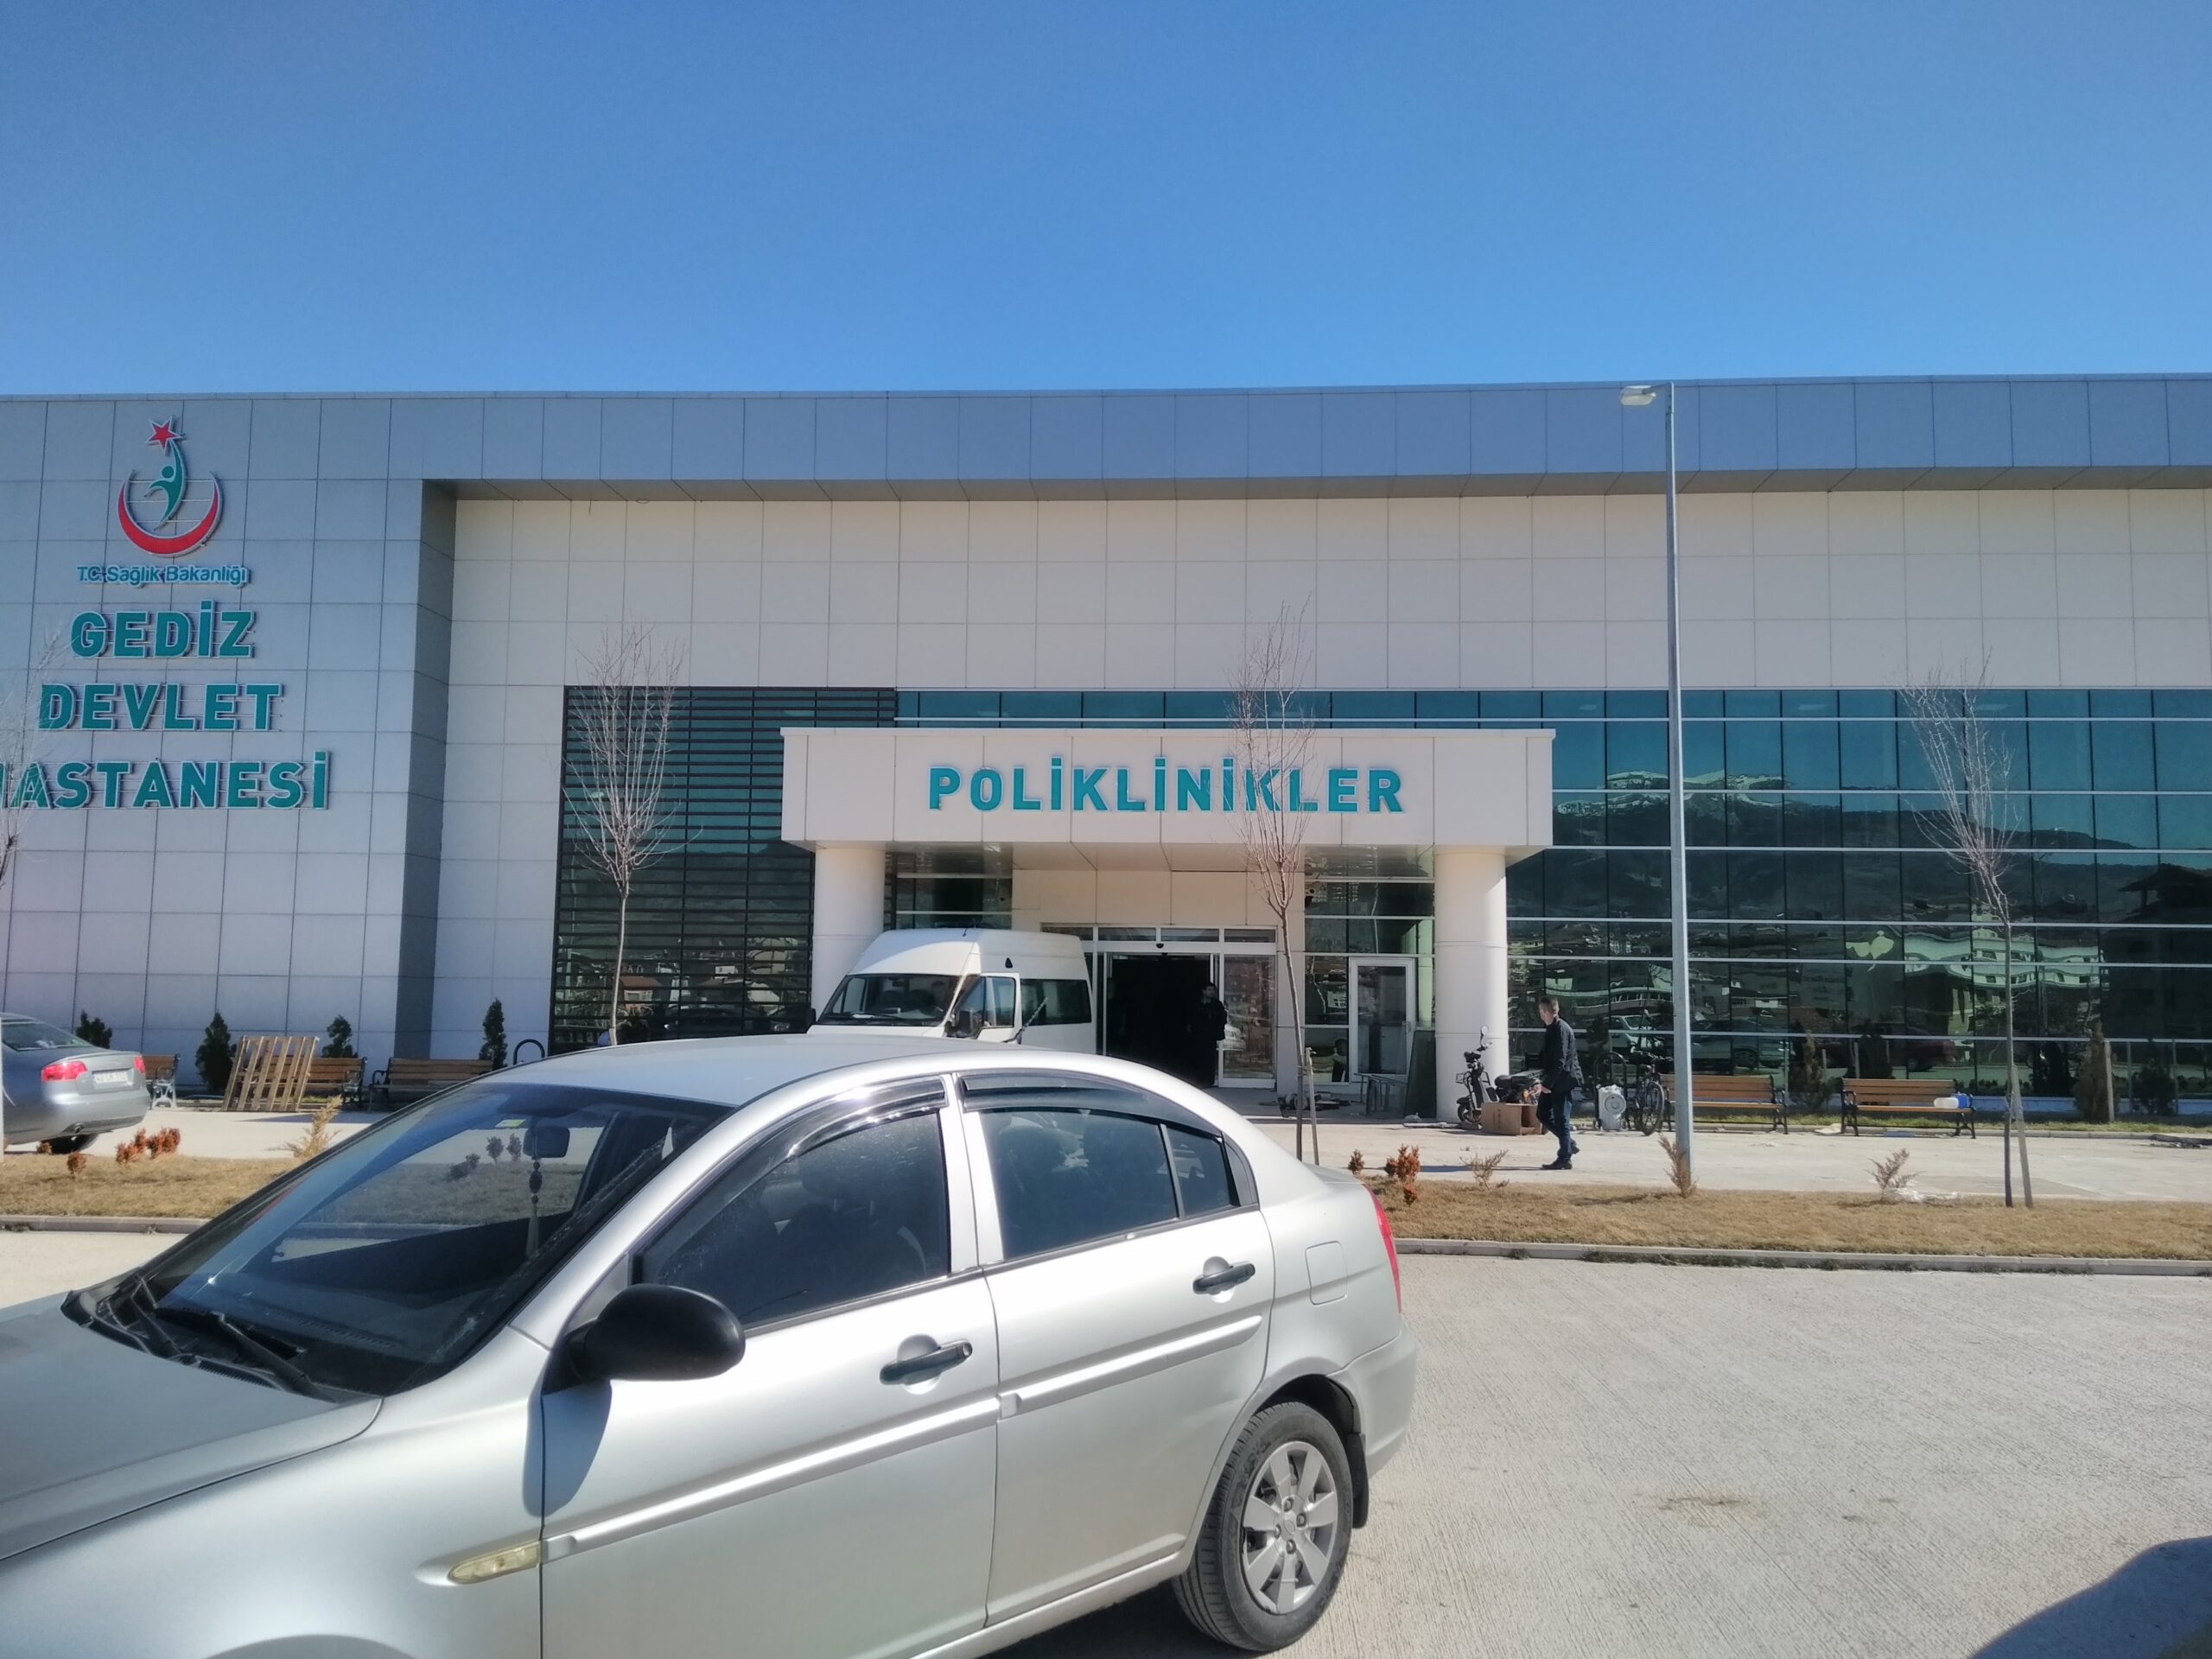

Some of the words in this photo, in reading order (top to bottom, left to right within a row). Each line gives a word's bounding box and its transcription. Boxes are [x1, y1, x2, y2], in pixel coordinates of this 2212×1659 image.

[106, 565, 159, 586] Sağlık
[166, 565, 246, 586] Bakanlığı
[70, 600, 255, 658] GEDİZ
[38, 683, 283, 731] DEVLET
[928, 755, 1404, 813] POLİKLİNİKLER
